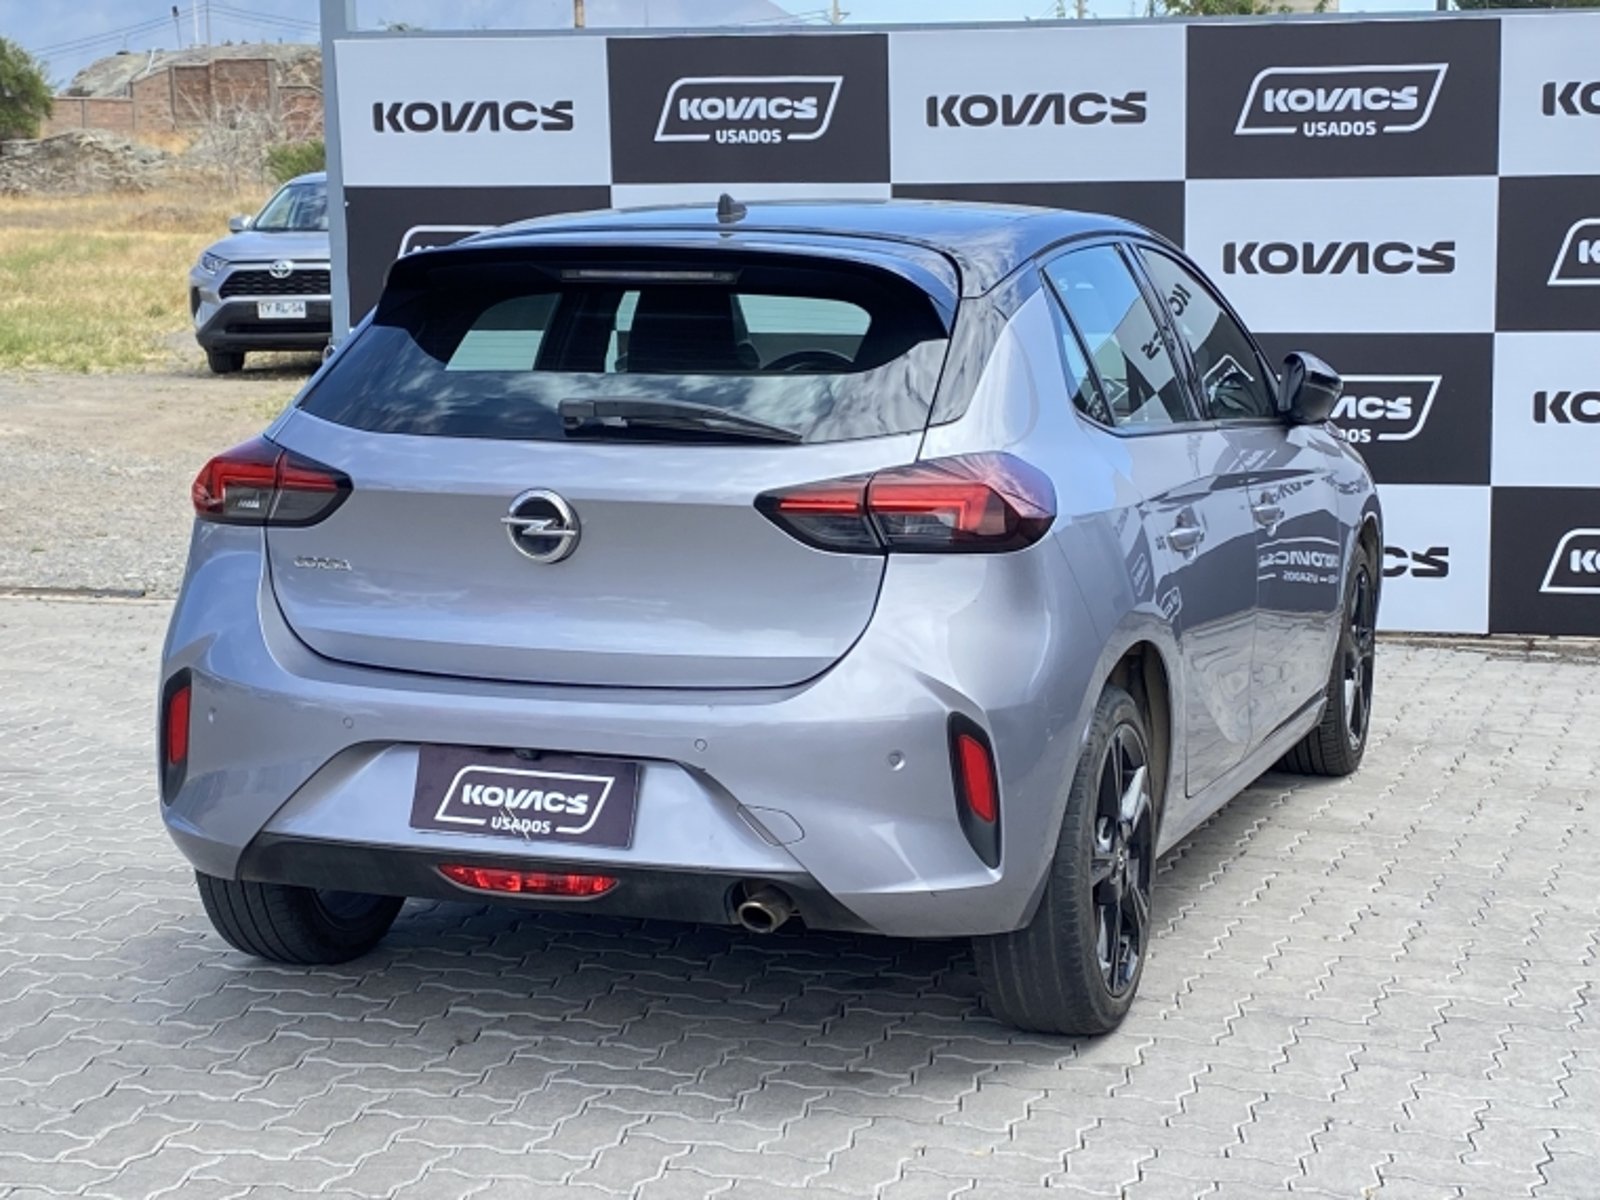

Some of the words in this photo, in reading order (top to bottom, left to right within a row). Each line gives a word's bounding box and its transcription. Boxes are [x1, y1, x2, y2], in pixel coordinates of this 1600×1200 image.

[679, 96, 818, 121] KOVACS
[926, 91, 1147, 127] KOVACS
[1264, 84, 1418, 112] KOVACS
[373, 101, 574, 133] KOVACS
[1303, 120, 1377, 137] USADOS
[715, 129, 782, 144] USADOS
[1223, 241, 1456, 274] KOVACS
[461, 784, 590, 816] KOVACS
[490, 815, 552, 835] USADOS
